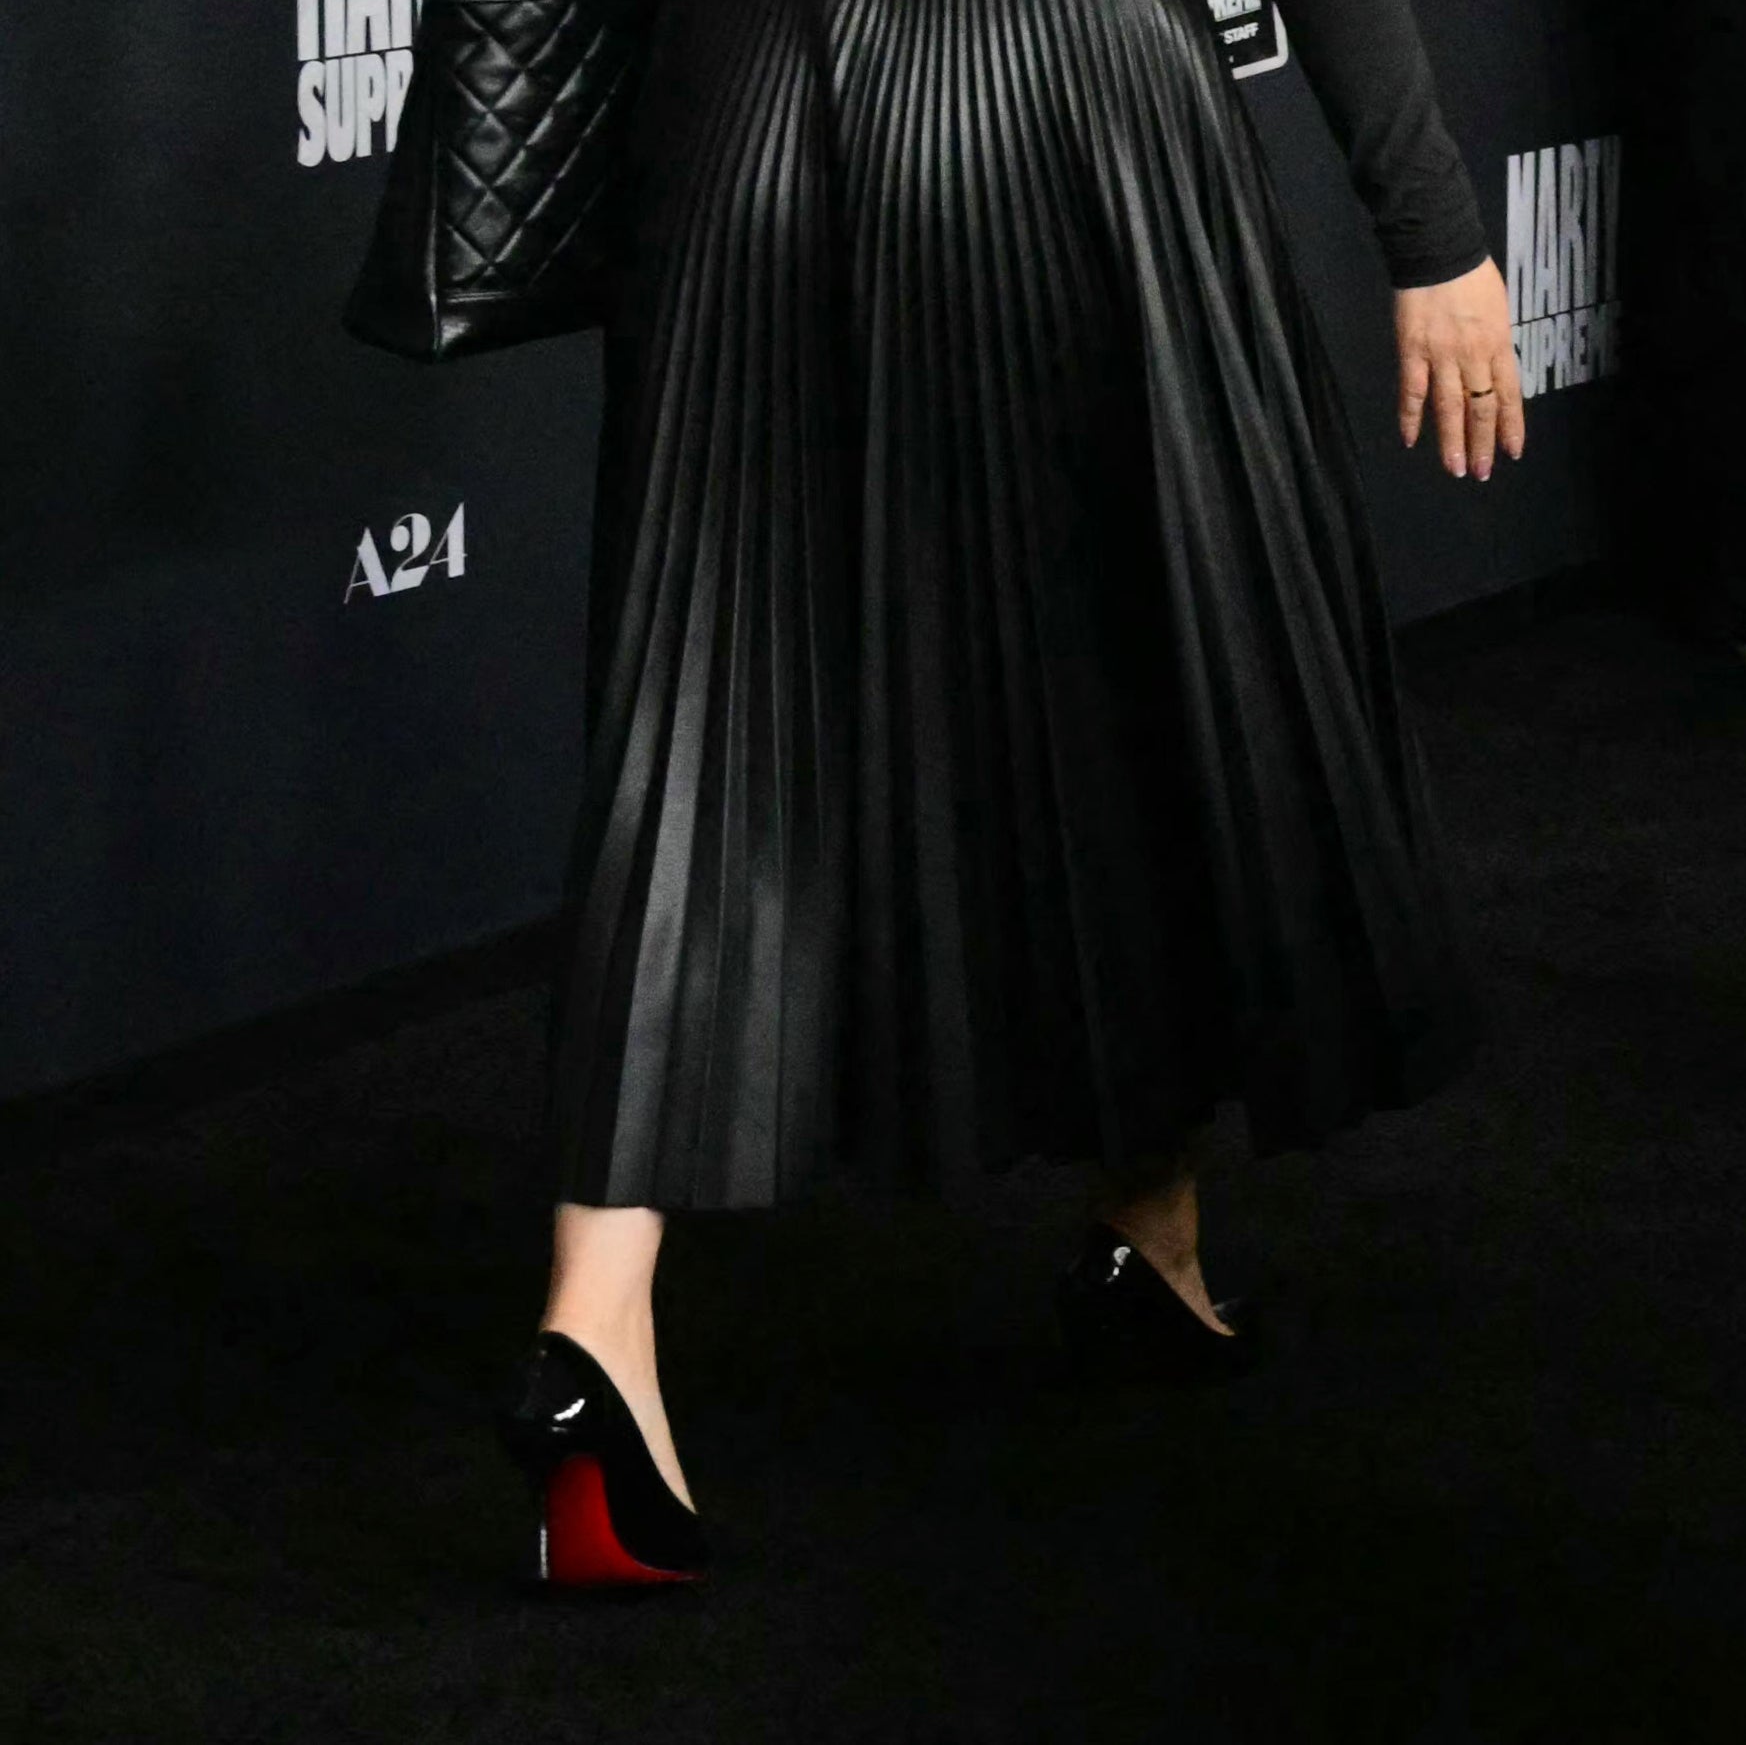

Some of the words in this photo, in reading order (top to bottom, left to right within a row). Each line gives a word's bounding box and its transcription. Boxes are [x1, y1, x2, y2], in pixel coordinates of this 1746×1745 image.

[1223, 21, 1260, 45] STAFF
[298, 49, 414, 167] SUPR
[1507, 135, 1621, 325] MARTY
[344, 502, 467, 604] A24
